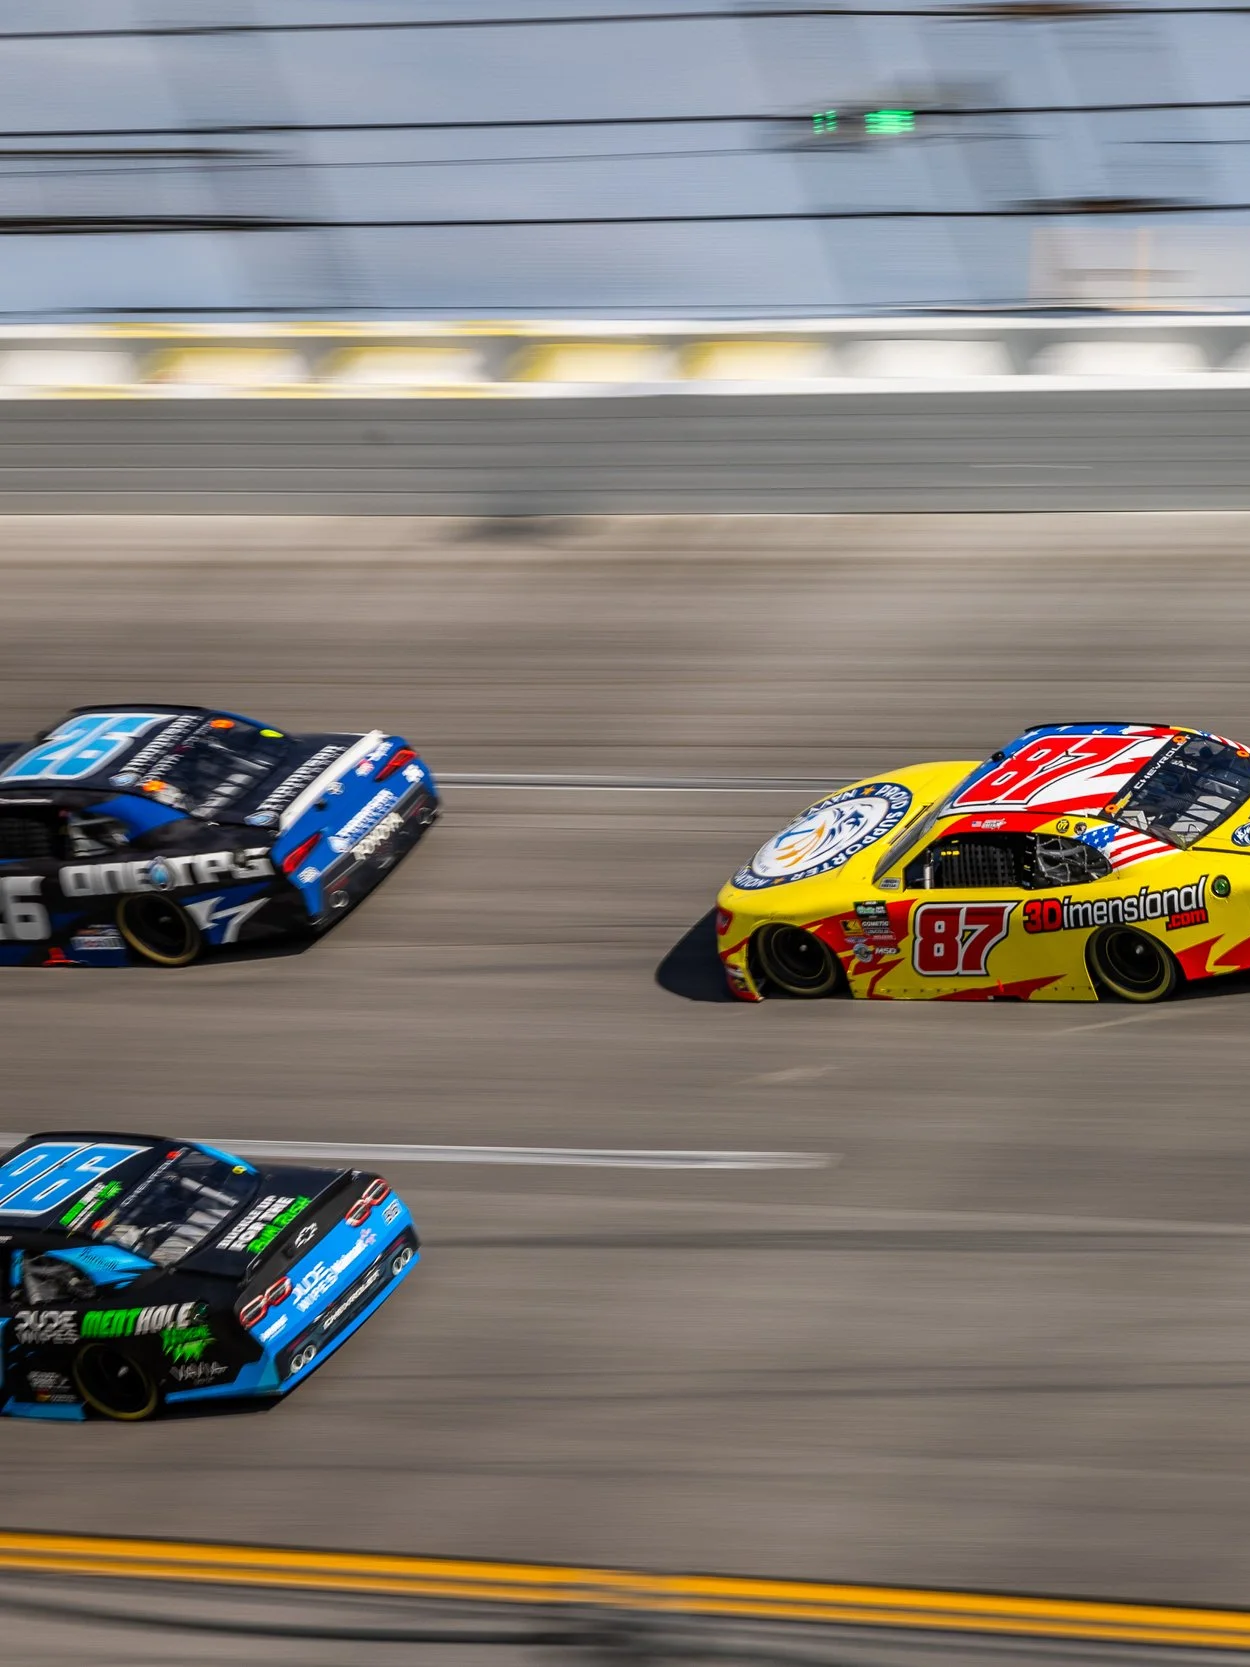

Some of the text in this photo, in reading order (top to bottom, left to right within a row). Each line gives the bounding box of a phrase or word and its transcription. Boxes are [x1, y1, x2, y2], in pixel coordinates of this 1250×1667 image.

[874, 784, 910, 809] PROUD
[951, 734, 1154, 808] 87
[790, 811, 905, 881] SUPPORTER
[0, 876, 52, 940] 6
[1023, 875, 1207, 933] 3Dimensional
[1168, 909, 1207, 929] .com
[912, 902, 1020, 977] 87
